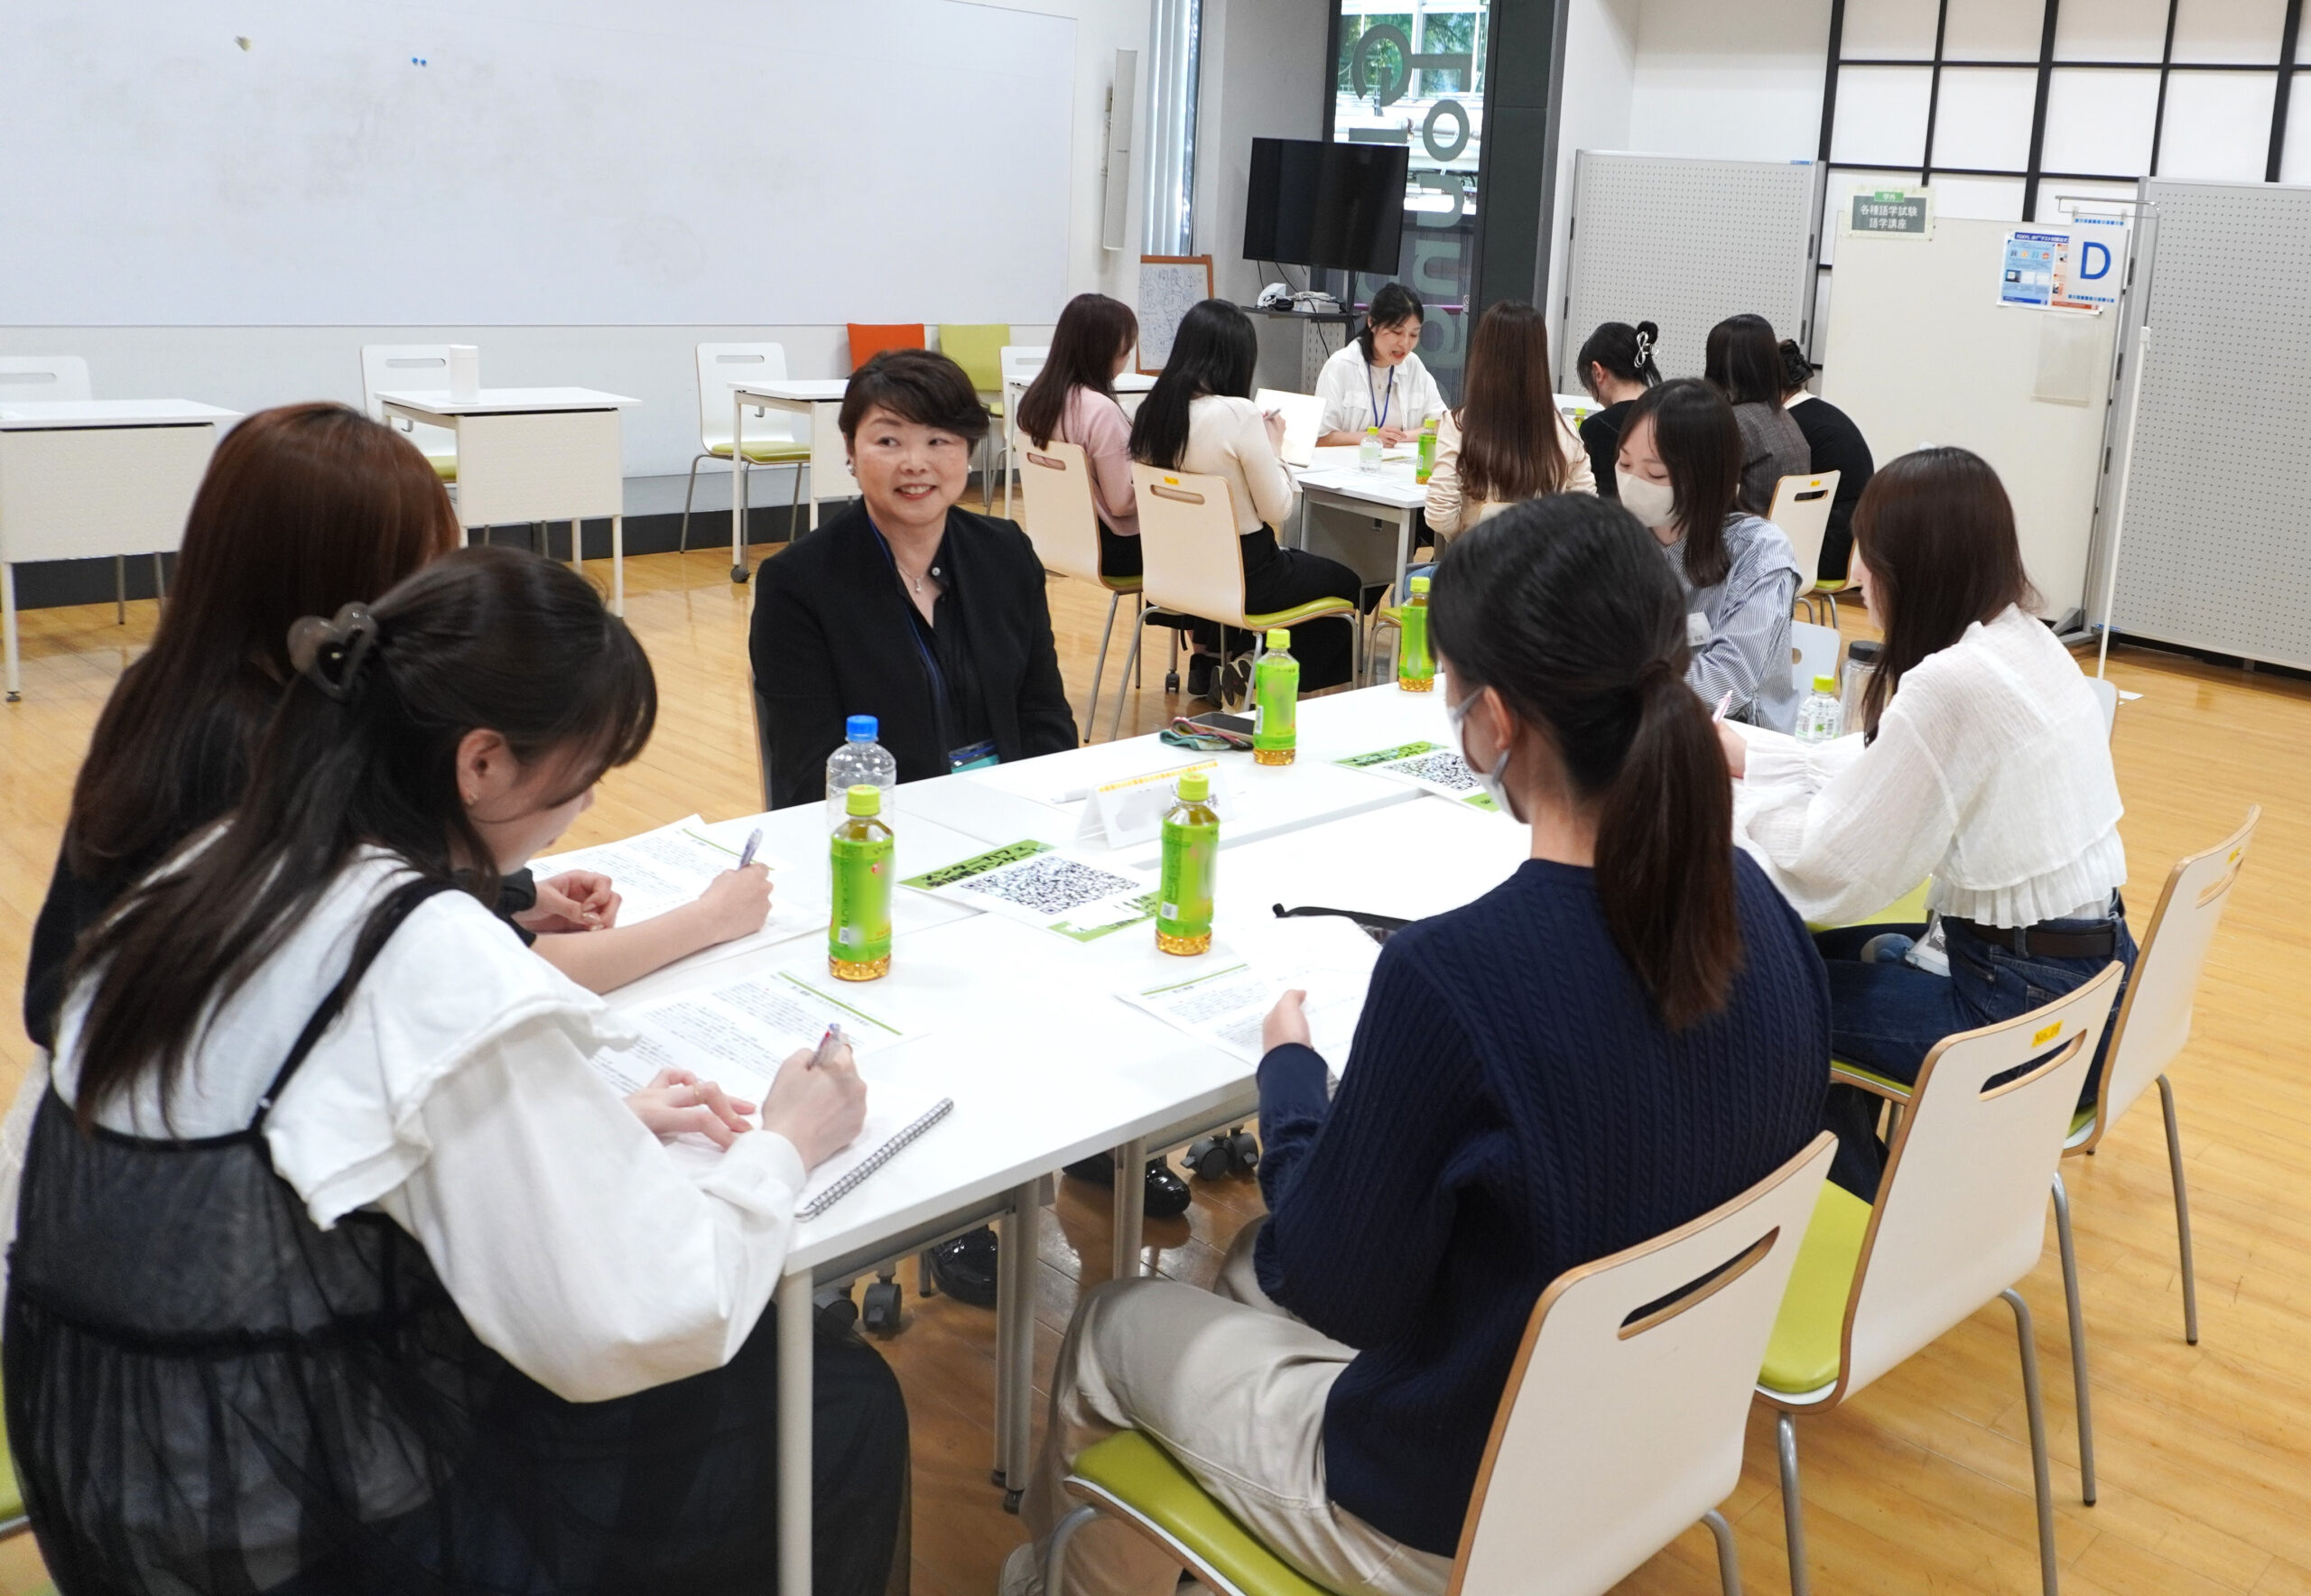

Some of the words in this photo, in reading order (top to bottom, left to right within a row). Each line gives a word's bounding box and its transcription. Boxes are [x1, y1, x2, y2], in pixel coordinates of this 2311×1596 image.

[1861, 204, 1918, 217] 各種語学試験
[1869, 218, 1907, 229] 語学講座
[2080, 241, 2111, 280] D
